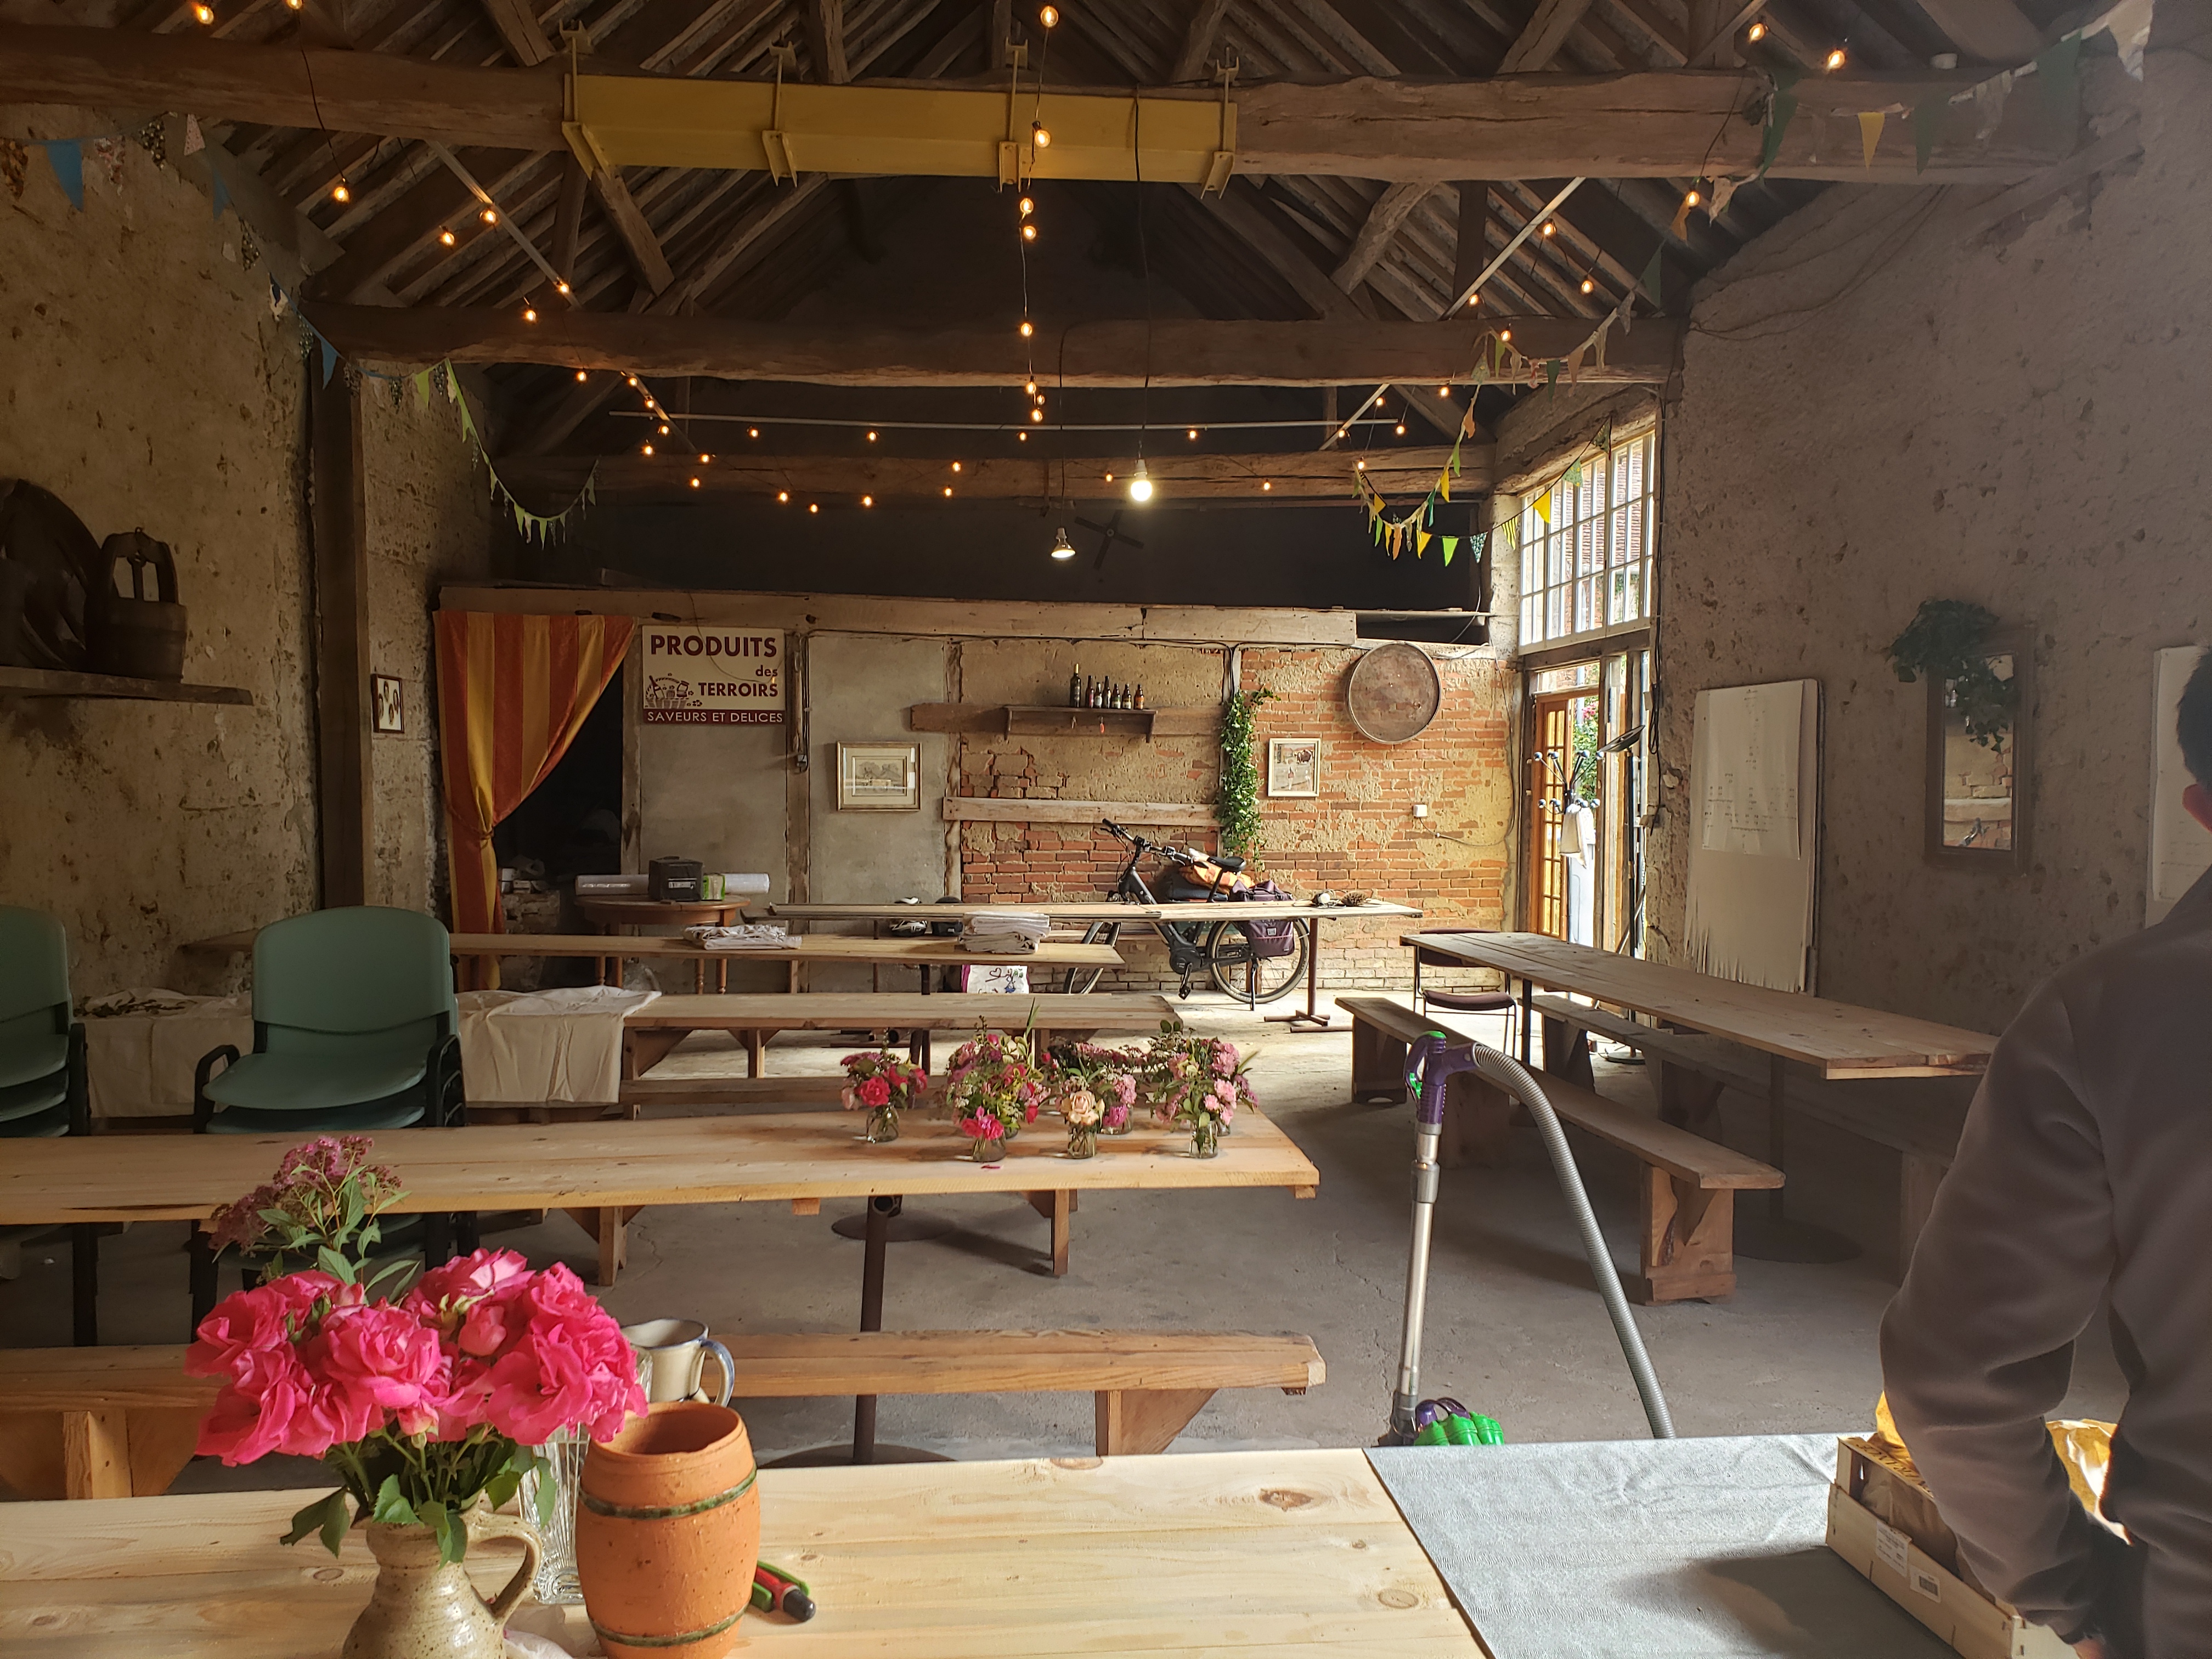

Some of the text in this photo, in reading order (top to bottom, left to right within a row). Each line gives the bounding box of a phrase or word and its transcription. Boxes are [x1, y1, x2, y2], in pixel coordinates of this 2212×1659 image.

[651, 635, 777, 657] PRODUITS
[755, 664, 778, 677] des
[698, 682, 778, 697] TERROIRS
[647, 712, 782, 723] SAVEURS ET DELICES
